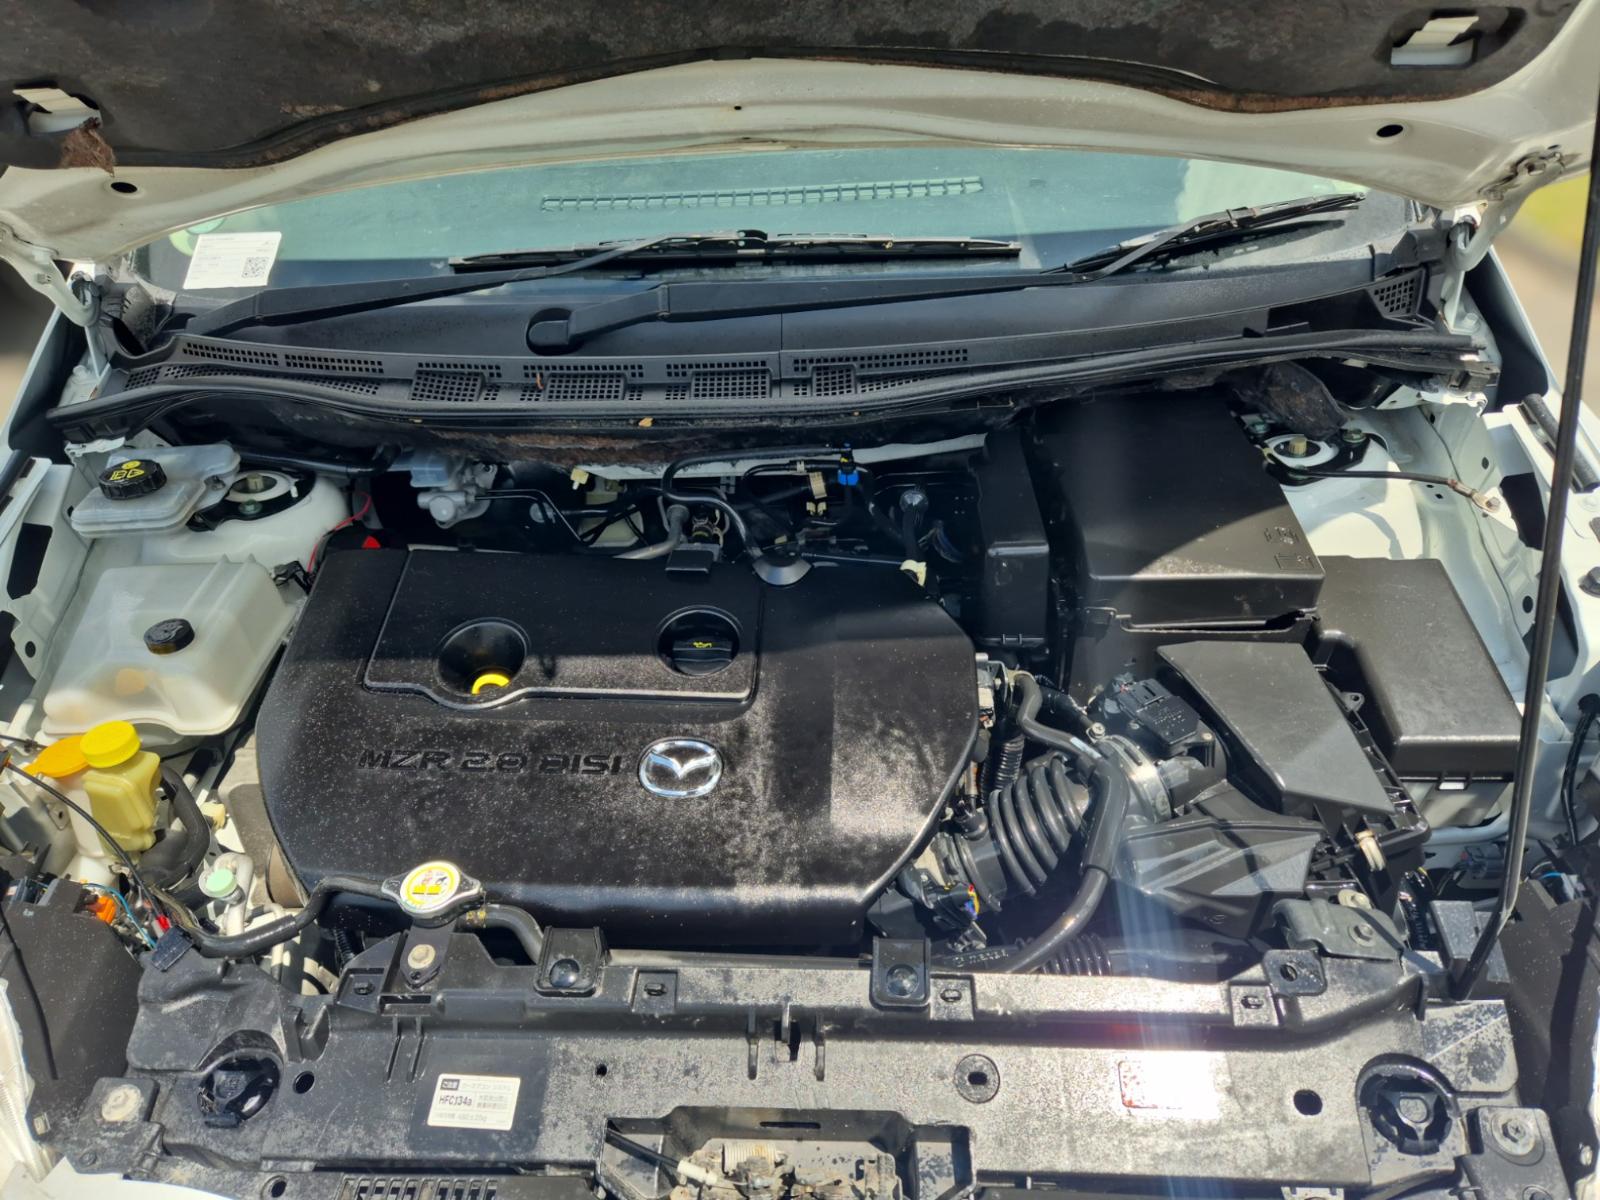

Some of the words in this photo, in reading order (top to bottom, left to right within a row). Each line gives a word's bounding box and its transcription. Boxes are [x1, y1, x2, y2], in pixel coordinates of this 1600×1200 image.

[357, 748, 450, 771] MZR
[540, 752, 621, 775] DISI
[439, 1095, 472, 1106] HFC134a
